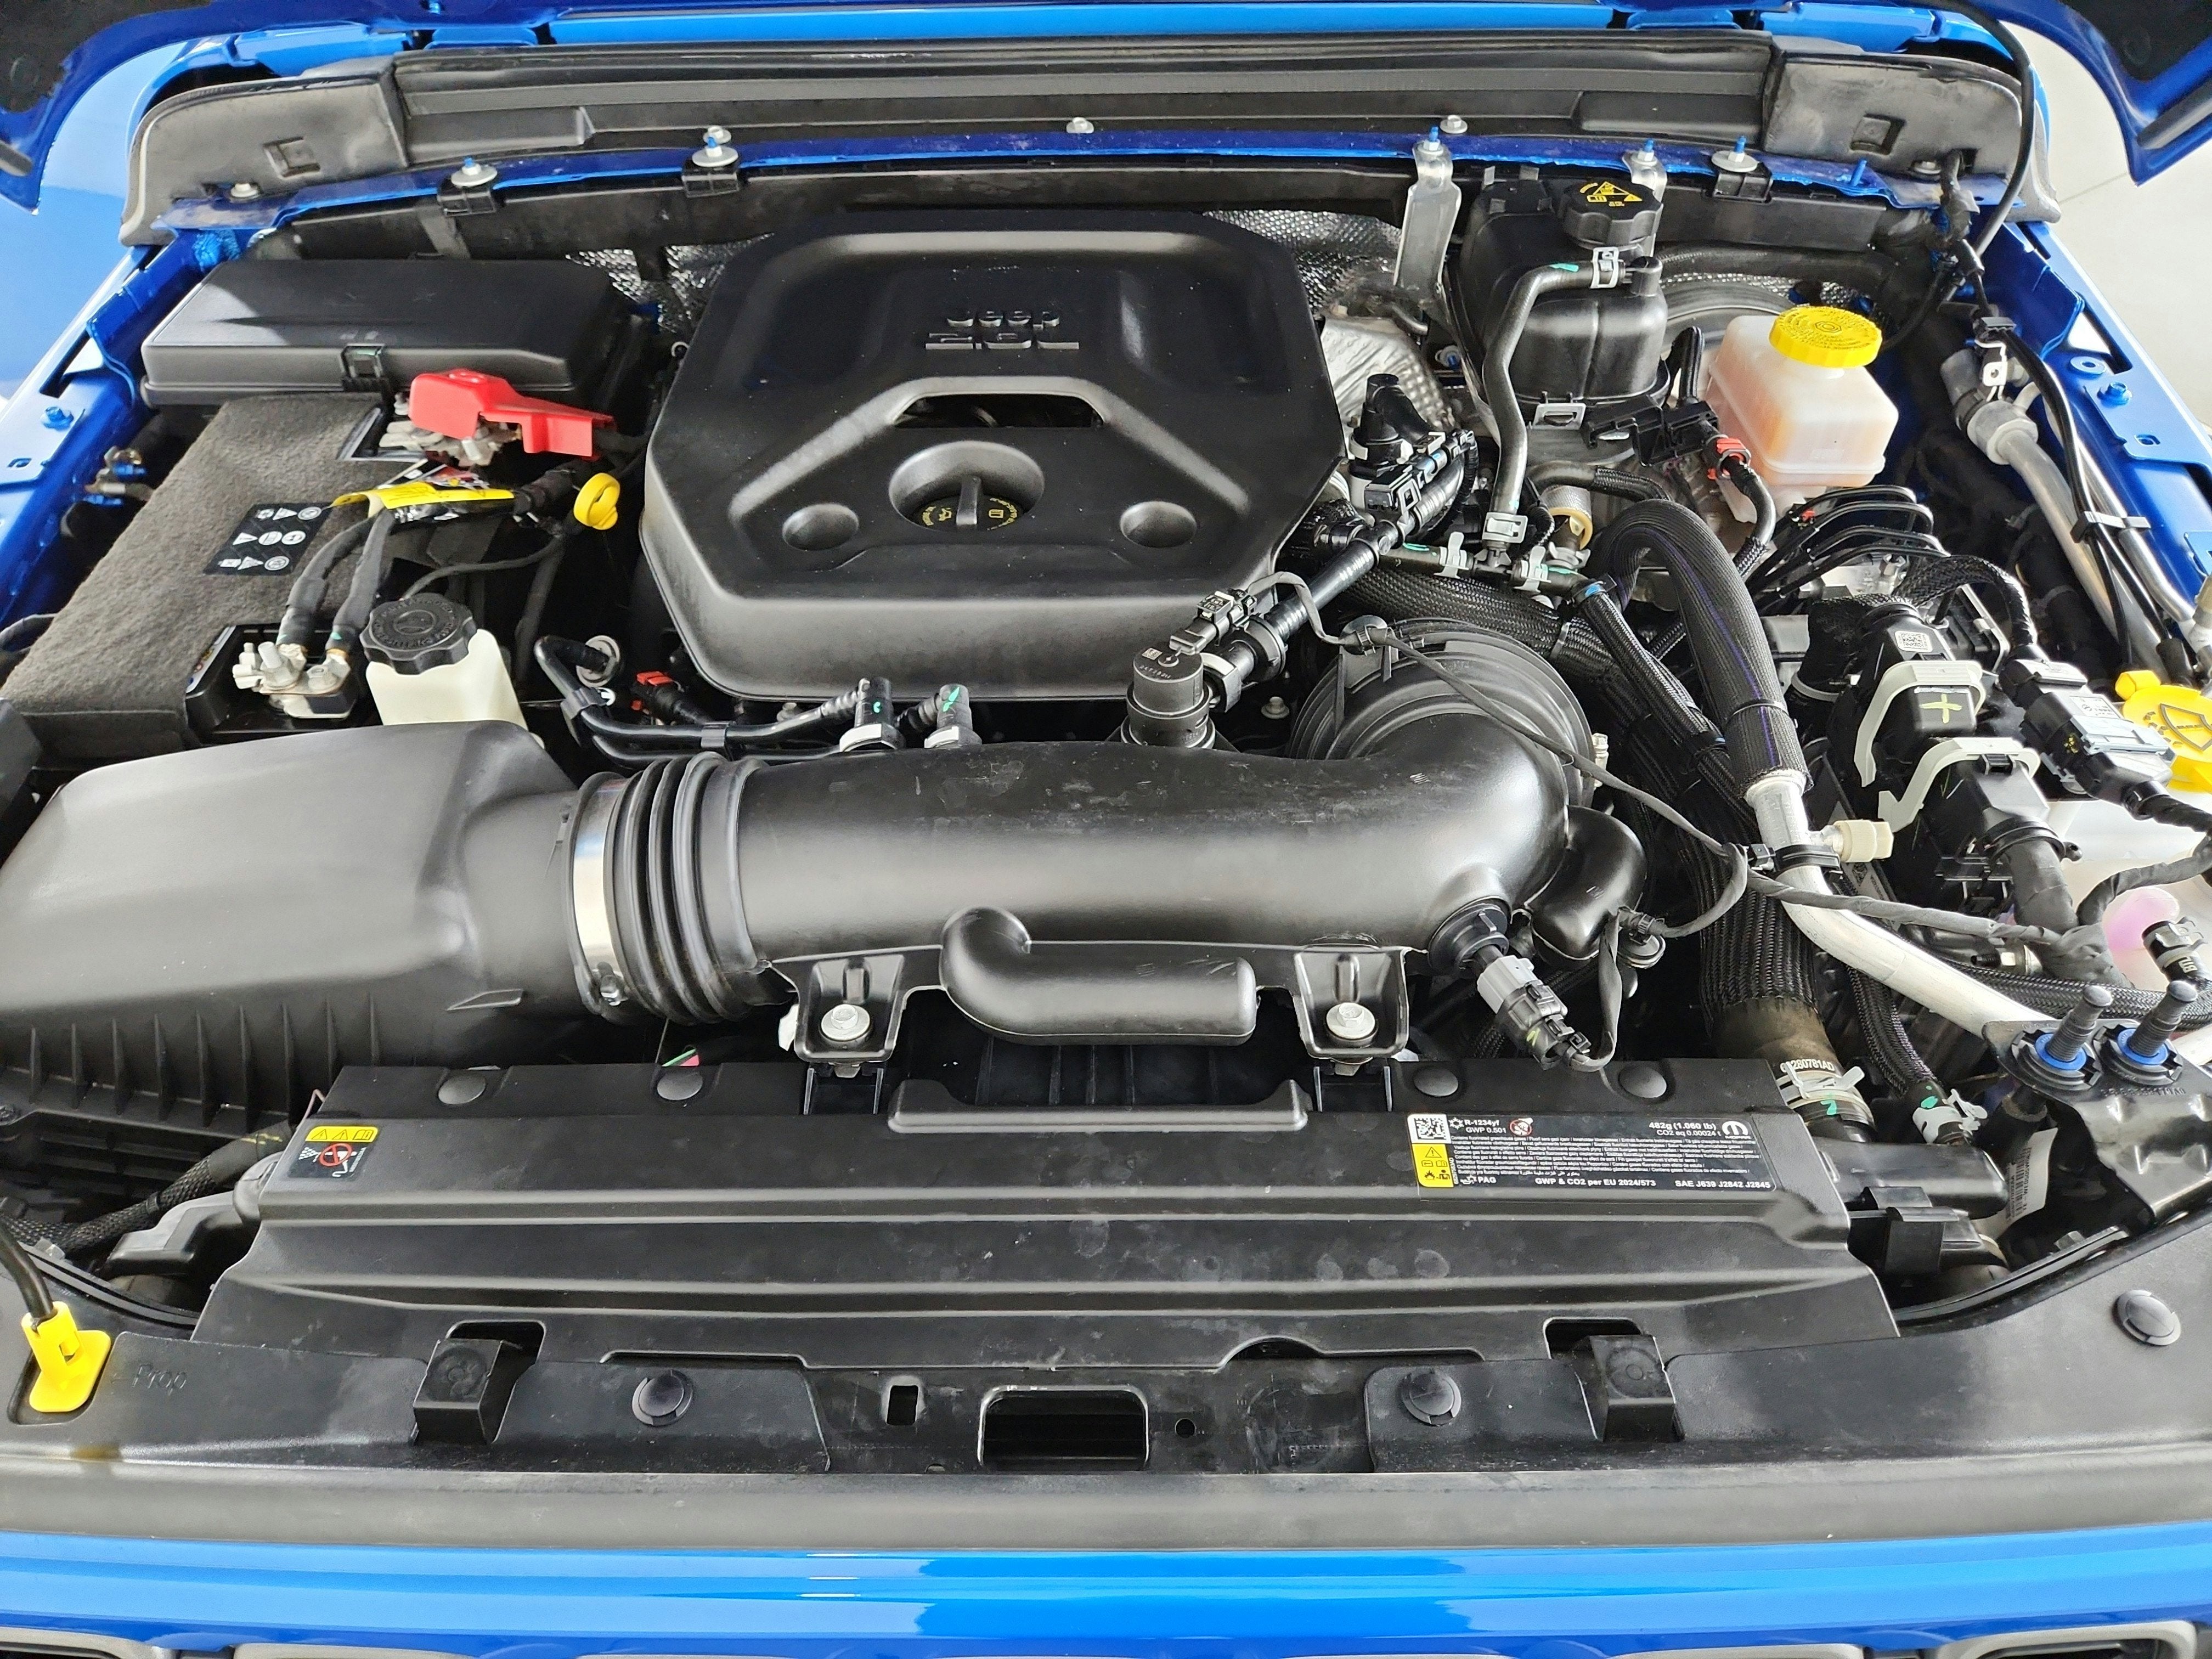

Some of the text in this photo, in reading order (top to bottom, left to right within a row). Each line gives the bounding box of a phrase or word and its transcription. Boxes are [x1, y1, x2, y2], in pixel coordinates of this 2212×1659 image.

[1780, 1059, 1835, 1073] 6280781AD
[1649, 1122, 1673, 1131] 482g
[1703, 1122, 1717, 1131] lb)
